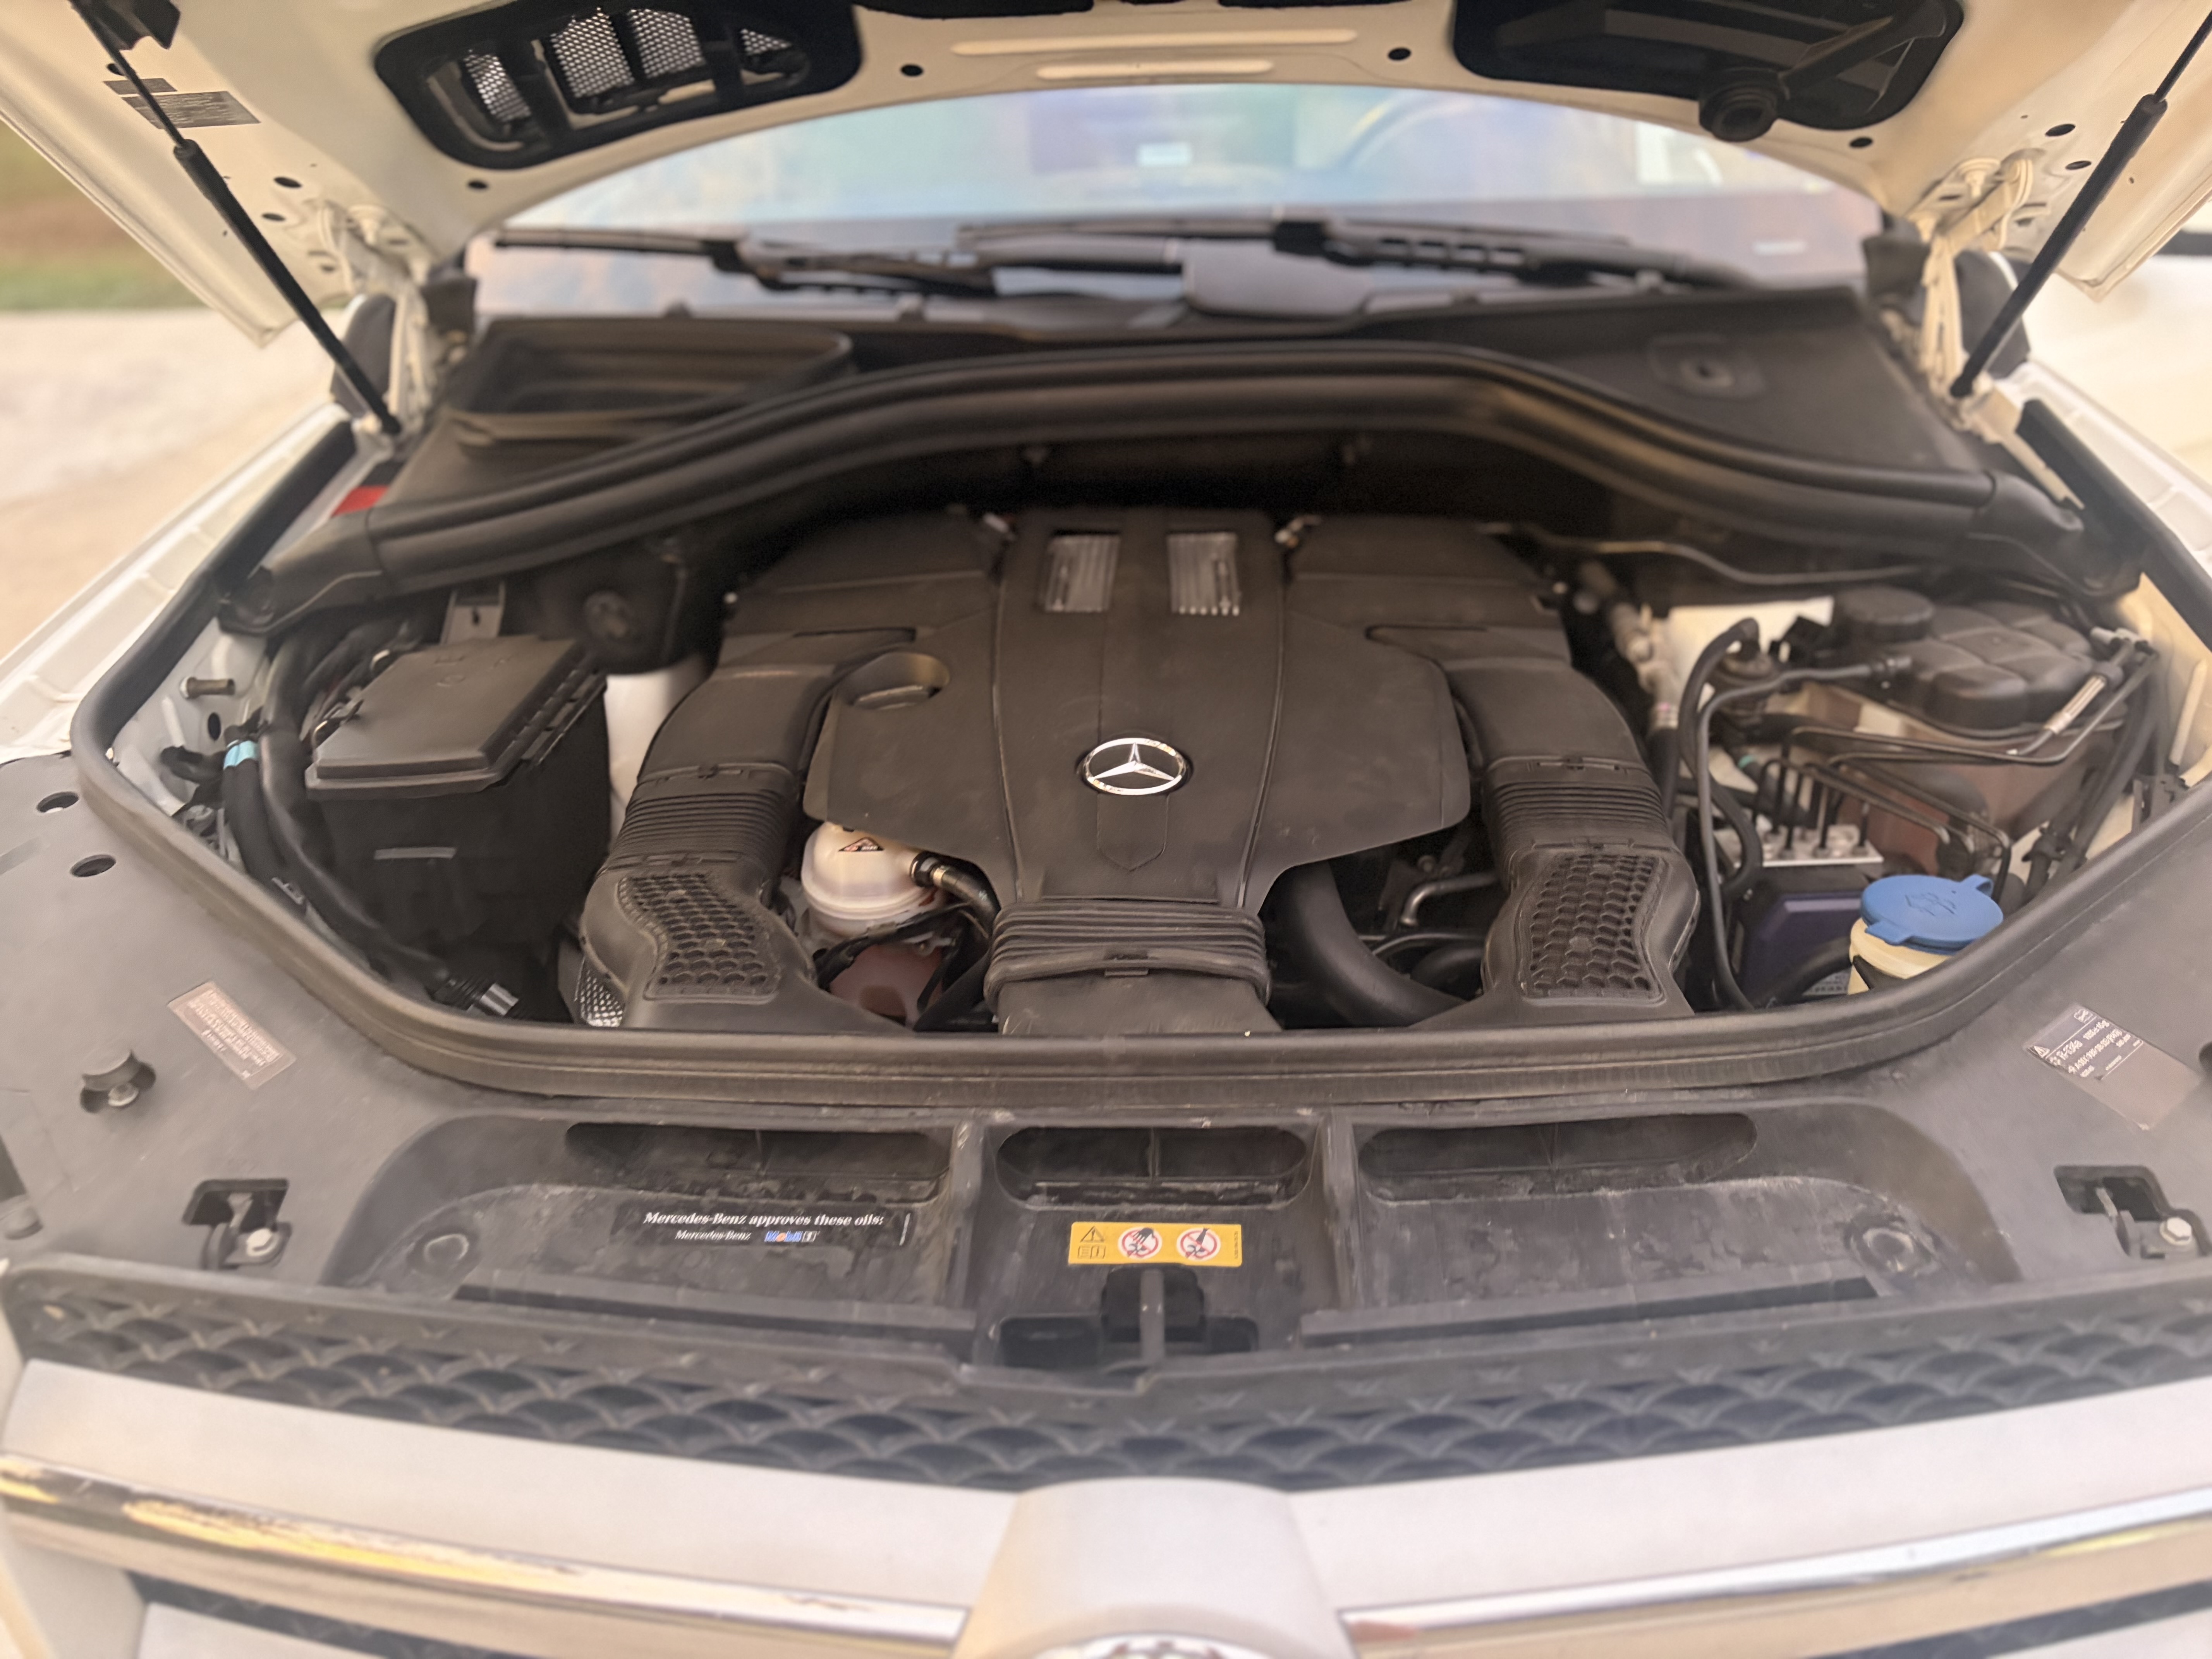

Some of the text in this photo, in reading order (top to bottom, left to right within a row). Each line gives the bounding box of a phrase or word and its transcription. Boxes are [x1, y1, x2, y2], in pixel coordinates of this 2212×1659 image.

[643, 1212, 747, 1224] Mercedes-Benz
[749, 1215, 812, 1227] approves
[814, 1214, 852, 1225] these
[675, 1230, 752, 1240] Mercedes-Benz
